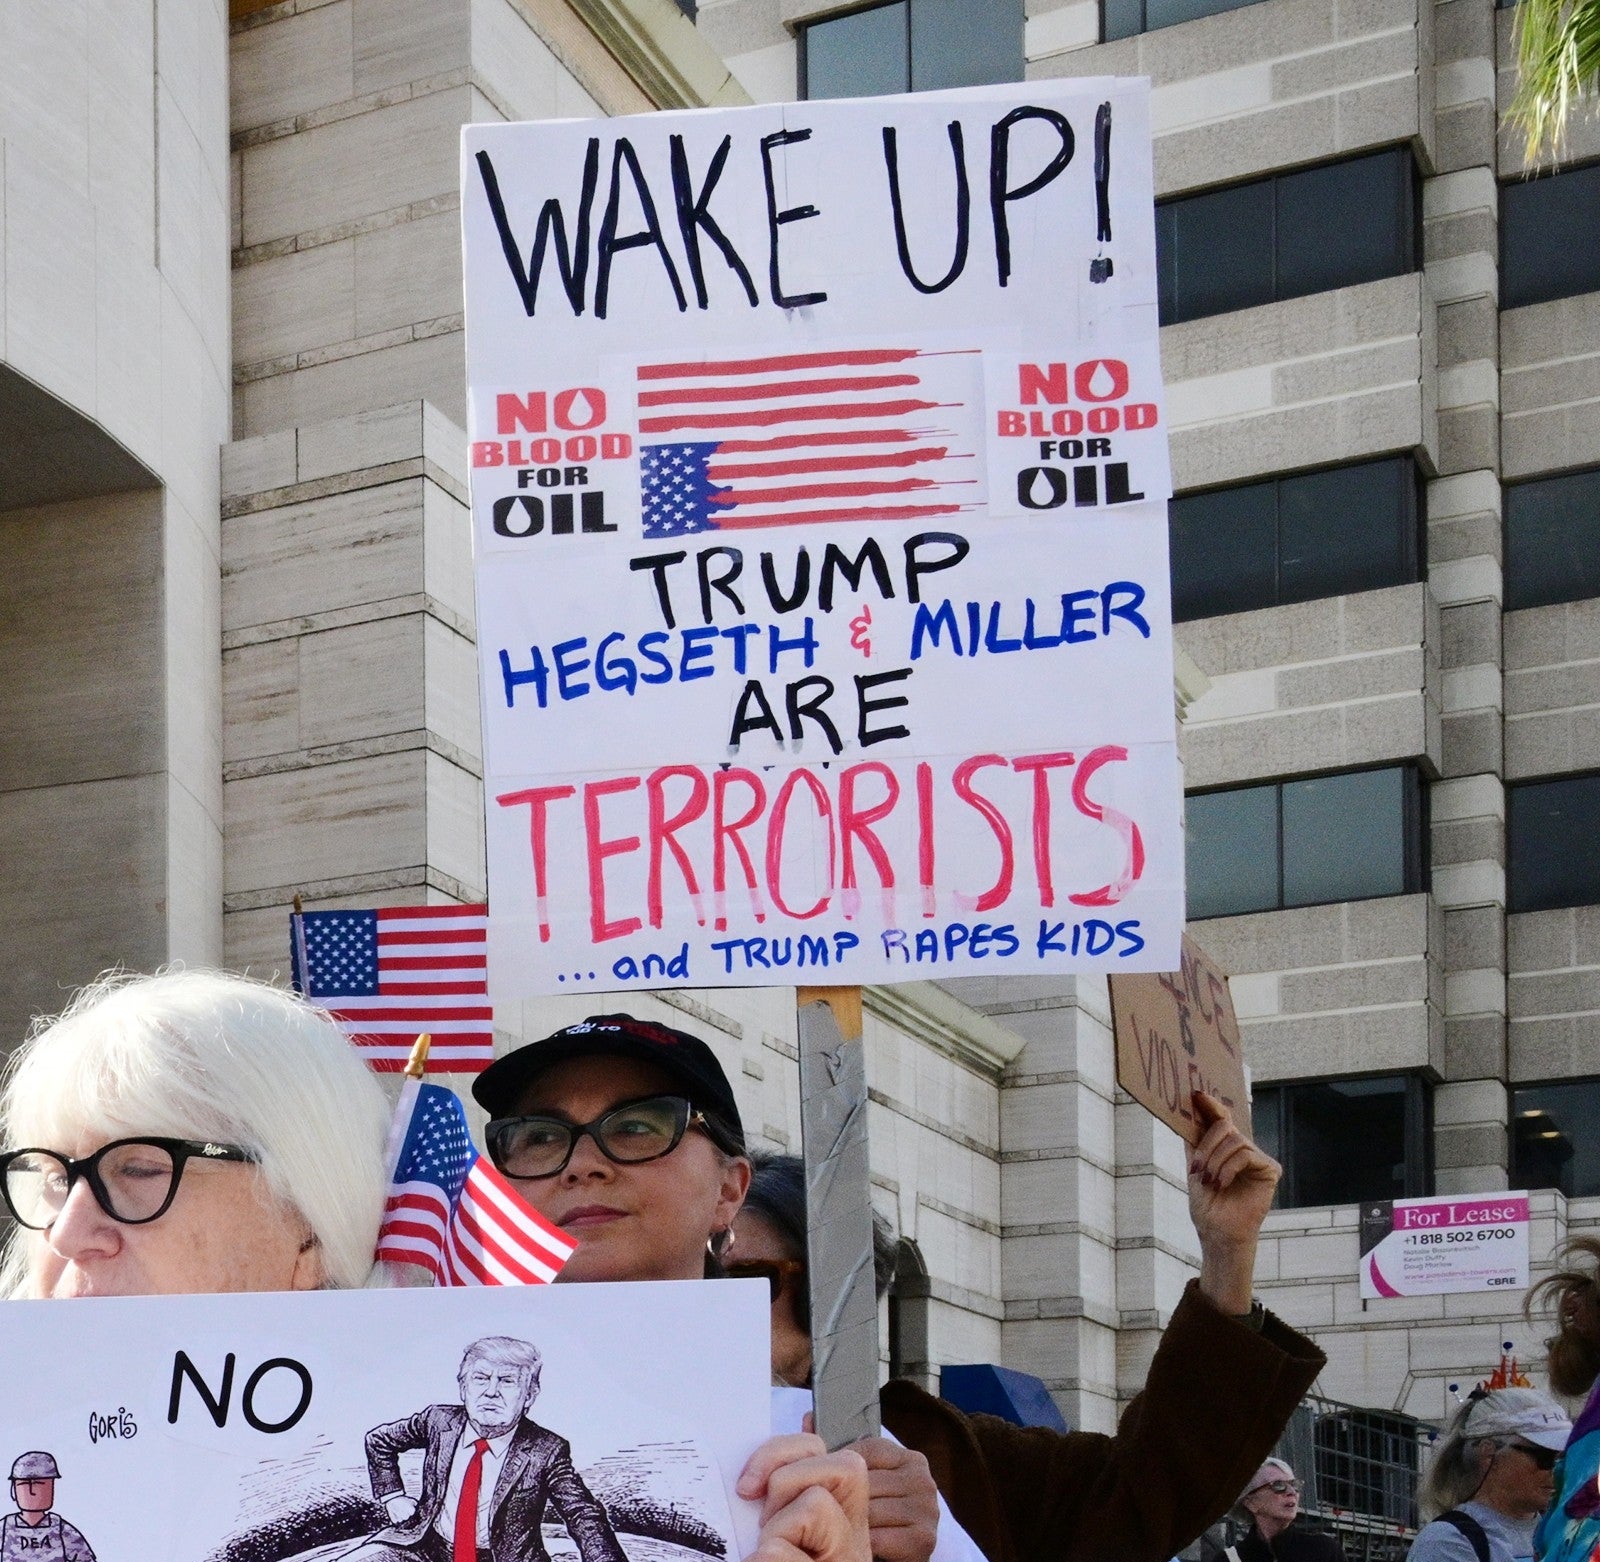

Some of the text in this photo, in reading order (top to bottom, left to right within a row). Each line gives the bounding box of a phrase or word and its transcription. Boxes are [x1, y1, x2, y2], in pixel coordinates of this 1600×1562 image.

[475, 101, 1113, 320] WAKE UP!
[1019, 359, 1130, 405] NO
[497, 387, 607, 435] NO
[998, 402, 1158, 438] BLOOD
[472, 433, 633, 468] BLOOD
[1040, 438, 1112, 460] FOR
[517, 467, 589, 488] FOR
[1017, 462, 1145, 510] OIL
[492, 491, 618, 539] OIL
[630, 532, 970, 630] TRUMP
[499, 580, 1151, 708] HEGSETH & MILLER
[728, 668, 913, 755] ARE
[495, 745, 1146, 943] TERRORISTS
[711, 931, 860, 969] TRUMP
[881, 921, 1020, 963] RAPES
[1037, 918, 1145, 959] KIDS
[1403, 1209, 1441, 1228] For
[1449, 1205, 1516, 1224] Lease
[1404, 1228, 1516, 1246] +1 818 502 6700
[1486, 1277, 1517, 1286] CBRE
[166, 1350, 313, 1434] NO
[20, 1536, 50, 1550] DEA
